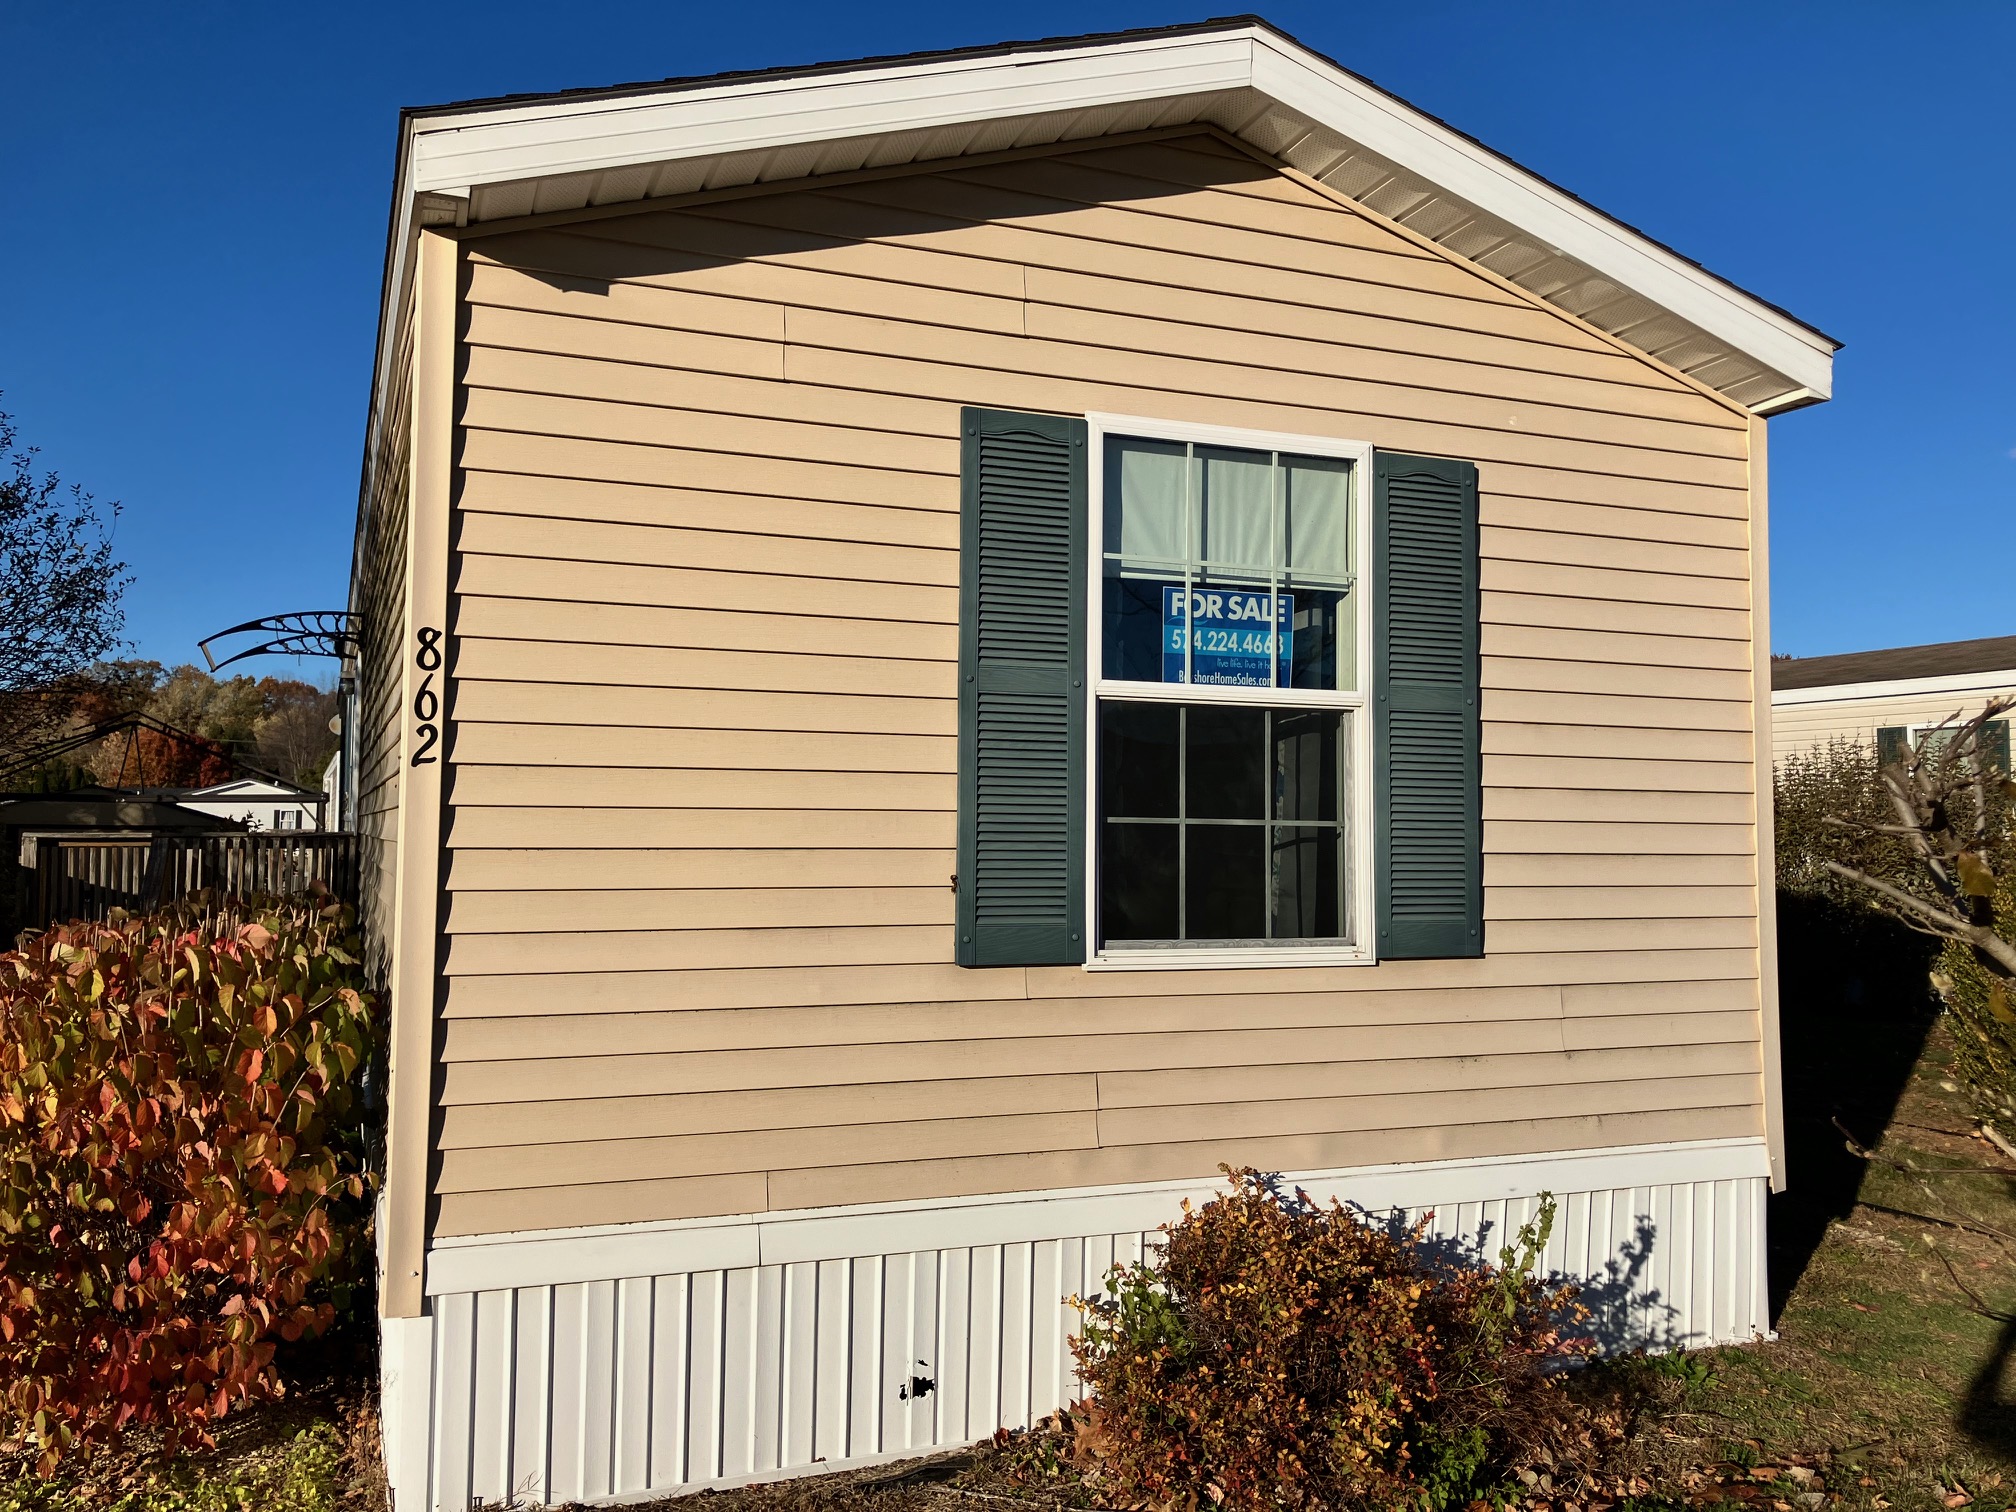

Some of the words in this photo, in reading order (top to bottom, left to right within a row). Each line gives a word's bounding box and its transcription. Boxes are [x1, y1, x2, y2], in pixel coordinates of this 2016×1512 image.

[1171, 592, 1223, 619] FOR
[1227, 595, 1285, 622] SALE
[1217, 657, 1229, 667] live
[1244, 659, 1256, 669] live
[1257, 660, 1264, 670] it
[411, 626, 443, 768] 862
